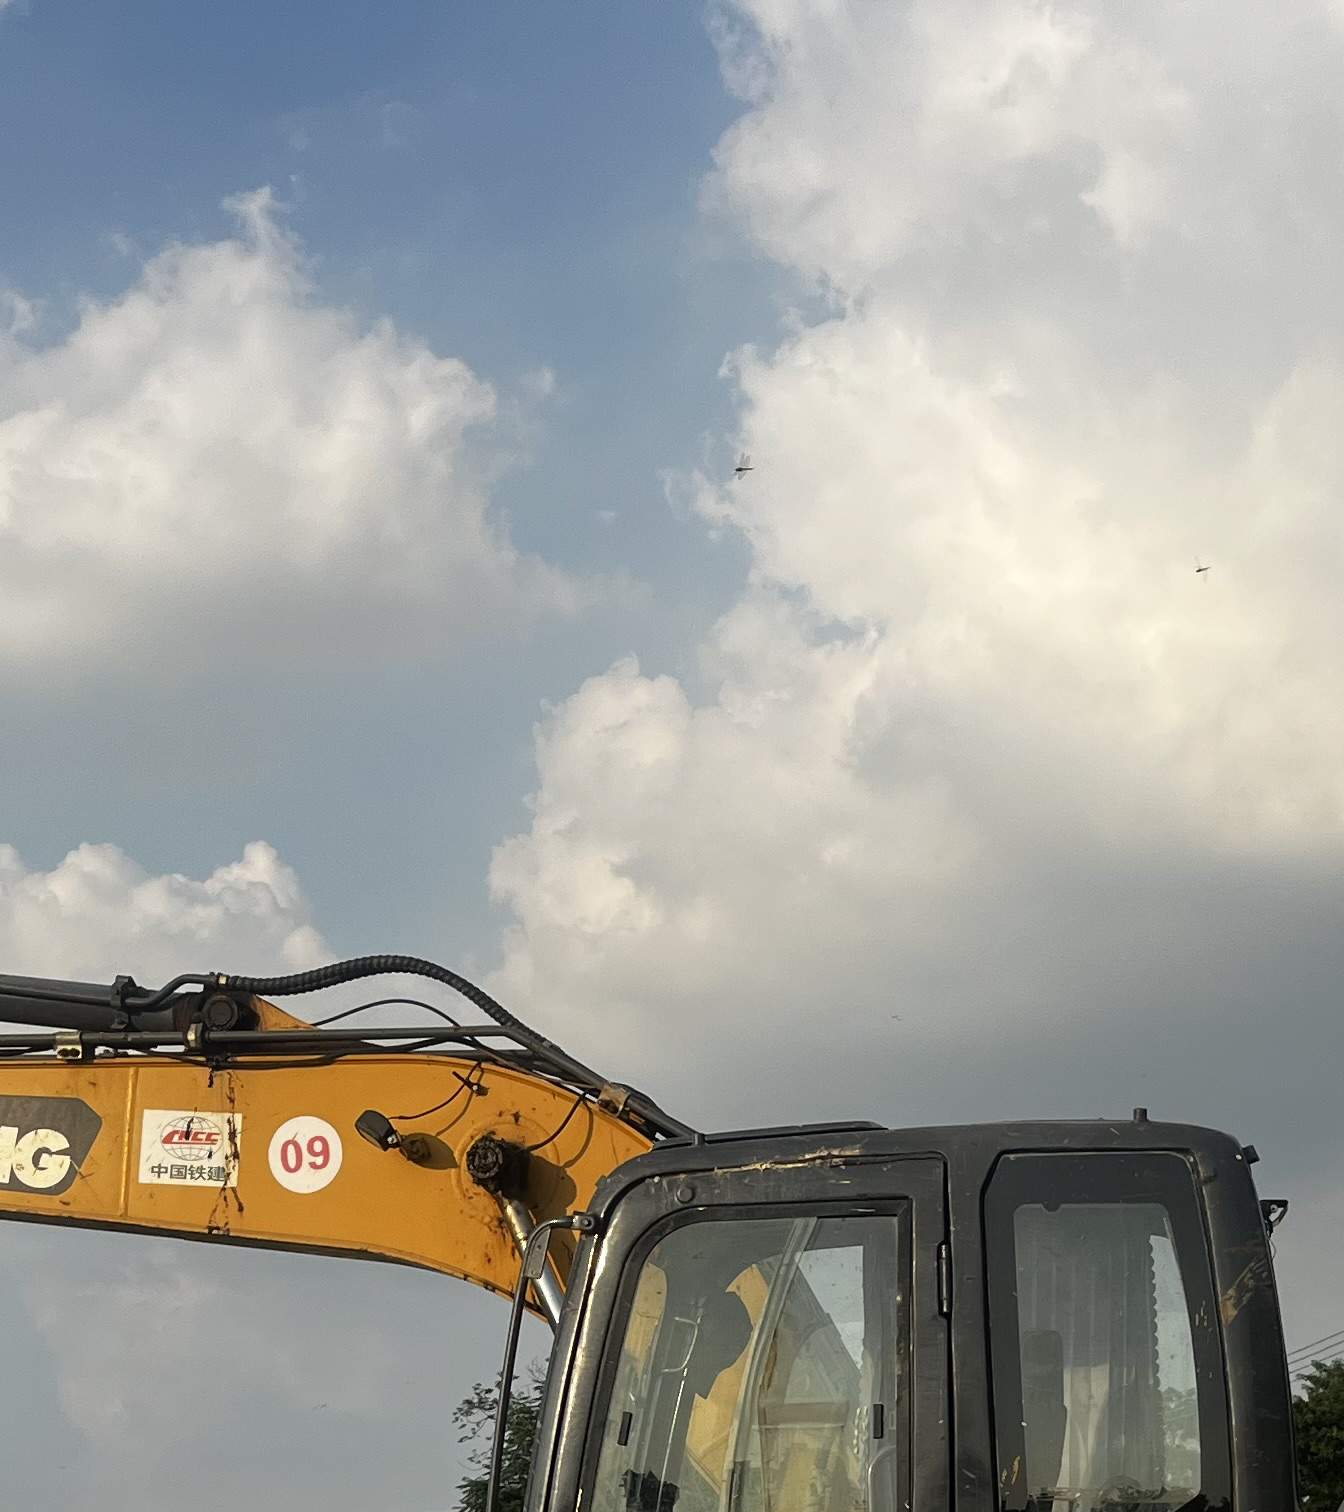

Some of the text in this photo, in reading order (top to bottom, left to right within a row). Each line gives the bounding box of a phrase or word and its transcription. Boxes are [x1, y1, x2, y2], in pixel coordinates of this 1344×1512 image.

[280, 1135, 331, 1174] 09
[150, 1163, 227, 1182] 中国铁建
